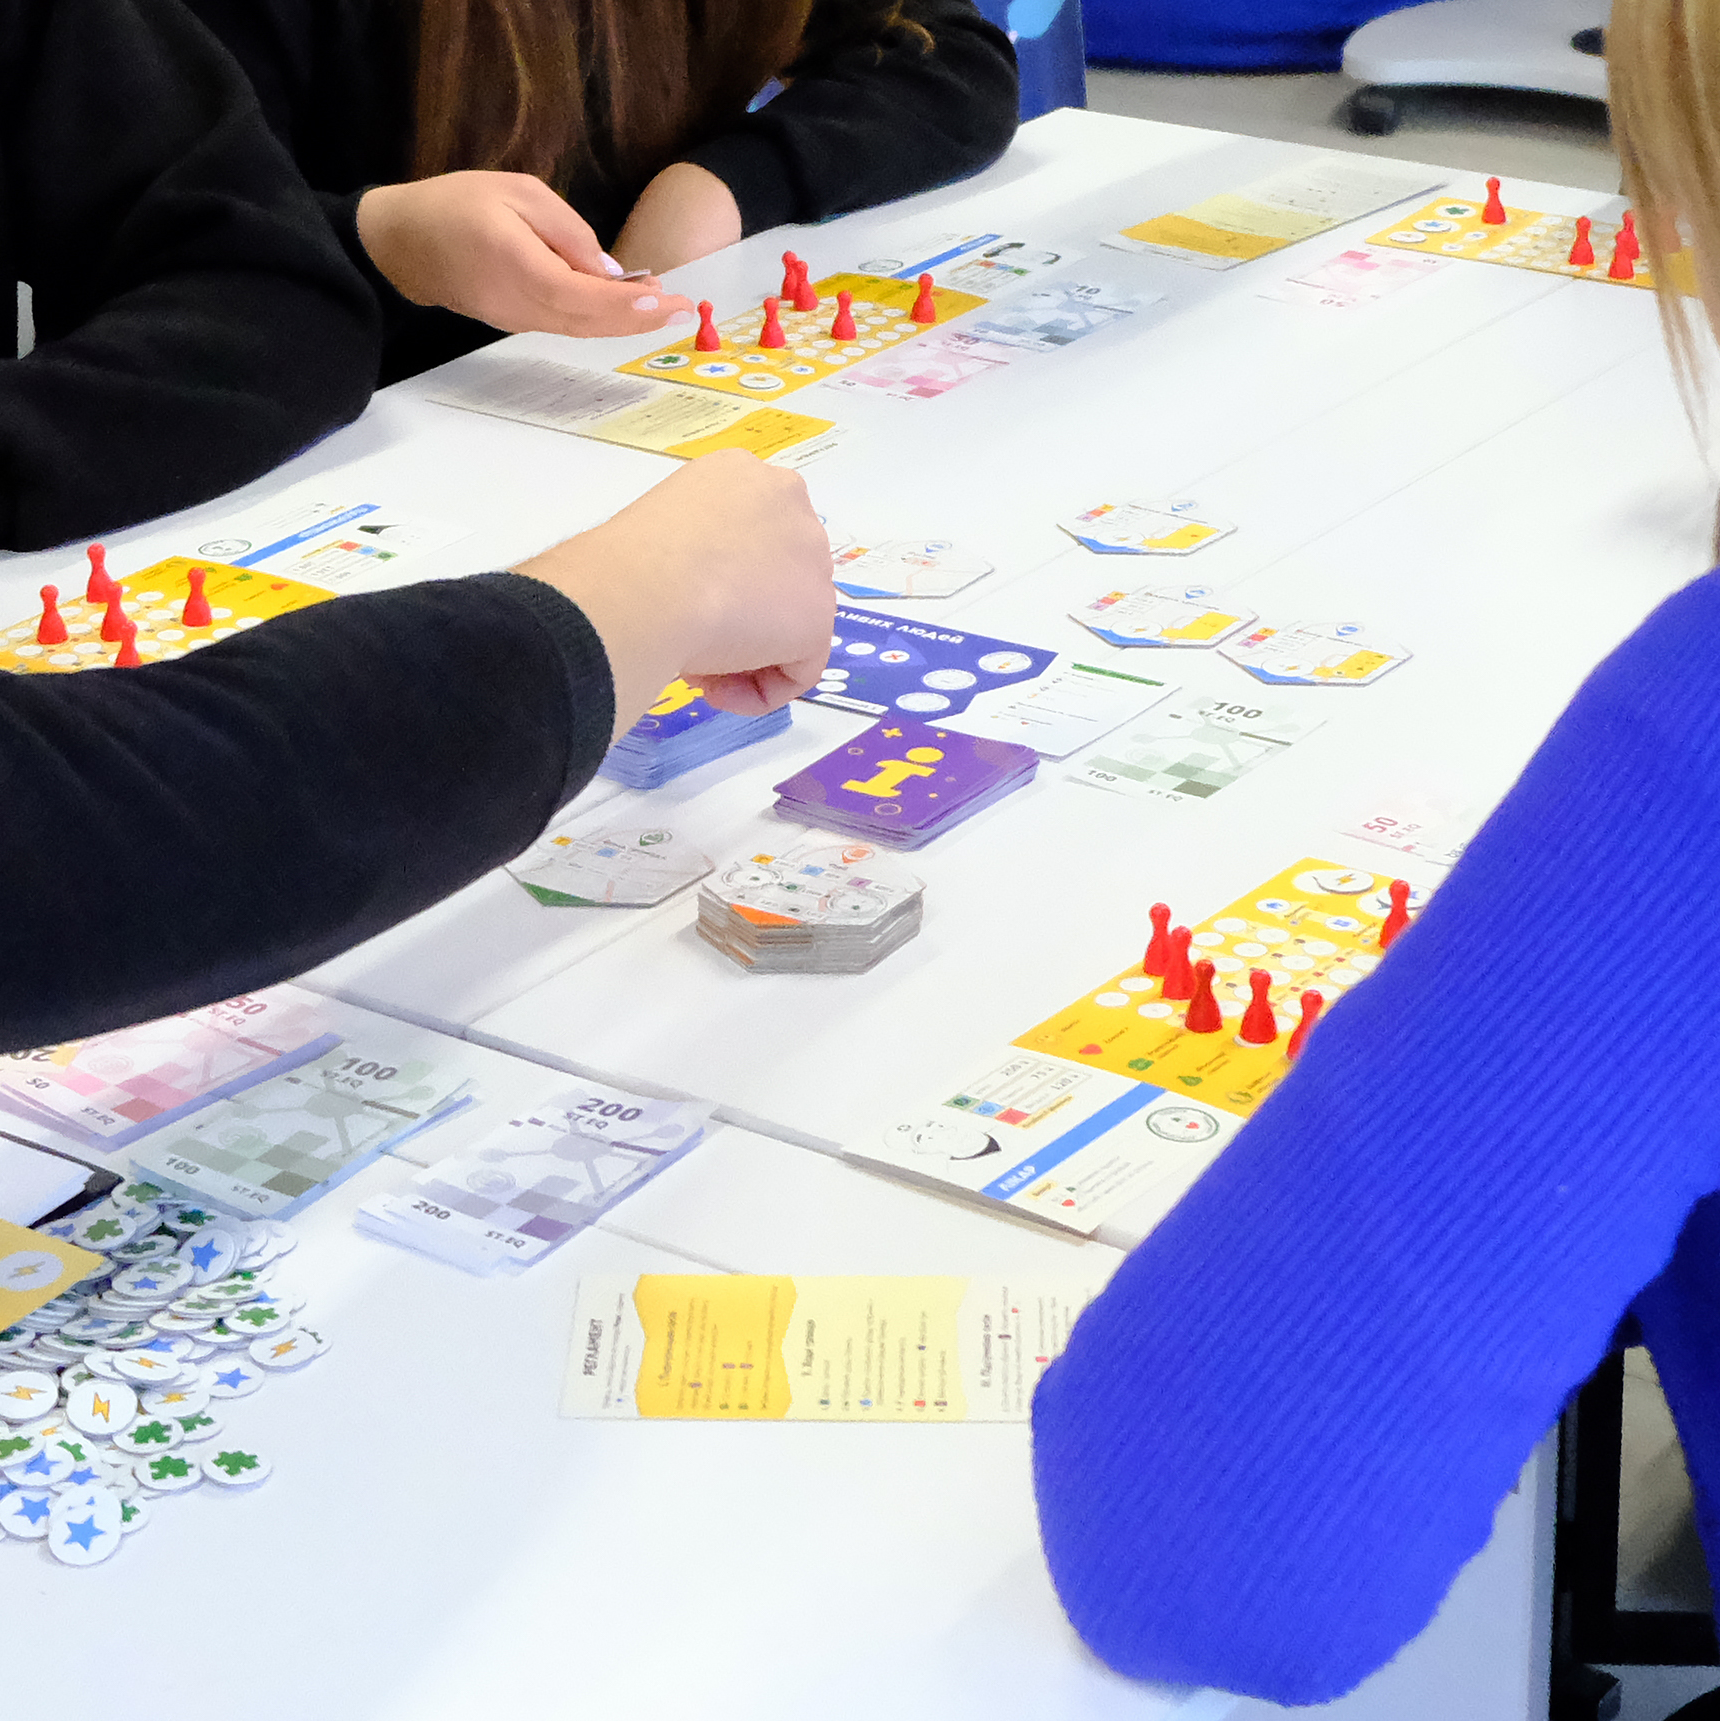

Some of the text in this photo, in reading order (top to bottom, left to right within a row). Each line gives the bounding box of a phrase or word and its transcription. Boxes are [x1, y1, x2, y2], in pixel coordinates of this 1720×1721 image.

[835, 610, 965, 645] ЛИВИХ ЛЮДЕЙ
[1212, 700, 1263, 720] 100
[1087, 768, 1117, 783] 100
[1361, 816, 1399, 833] 50
[338, 1056, 399, 1081] 100
[26, 1077, 51, 1090] 50
[576, 1097, 644, 1122] 200
[165, 1156, 202, 1175] 100
[411, 1199, 451, 1221] 200
